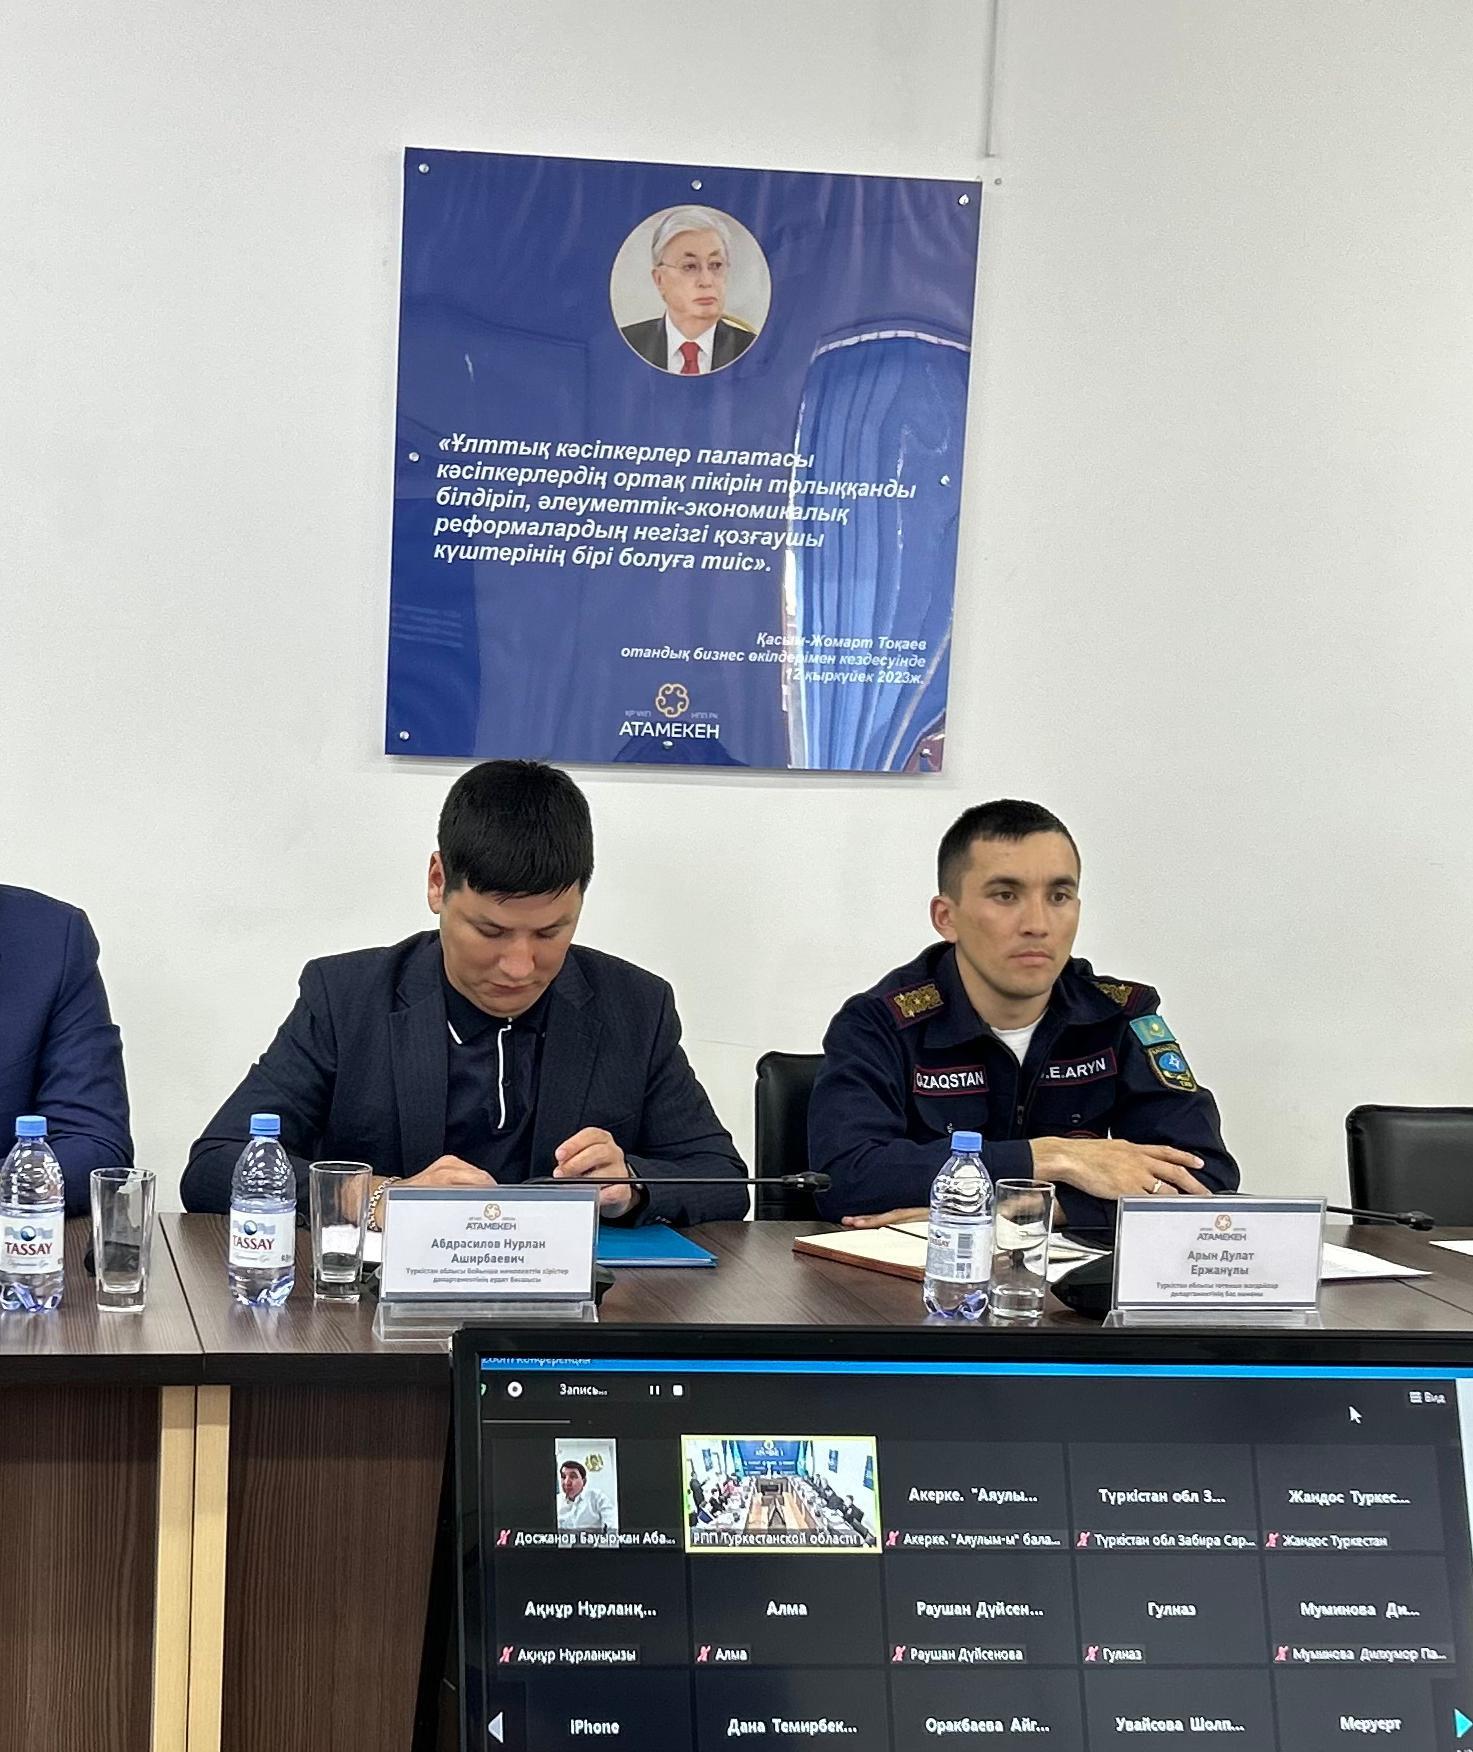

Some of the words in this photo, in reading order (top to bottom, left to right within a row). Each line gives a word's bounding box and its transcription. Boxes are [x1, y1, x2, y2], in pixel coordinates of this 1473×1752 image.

[439, 433, 552, 459] «Ұлттық
[555, 439, 691, 468] кәсіпкерлер
[697, 447, 814, 469] палатасы
[436, 461, 608, 488] кәсіпкерлердің
[613, 471, 686, 493] ортақ
[691, 472, 763, 496] пікірін
[768, 479, 917, 500] толыққанды
[436, 486, 531, 512] білдіріп,
[433, 514, 628, 543] реформалардың
[633, 523, 709, 544] негізгі
[713, 529, 825, 551] қозғаушы
[433, 543, 566, 567] күштерінің
[571, 546, 614, 569] бірі
[618, 547, 695, 573] болуға
[701, 552, 772, 572] тиіс».
[878, 636, 927, 652] Тоқаев
[620, 646, 691, 662] отандық
[693, 647, 745, 662] бизнес
[839, 653, 926, 669] кездесуінде
[878, 671, 925, 685] 2023ж.
[619, 721, 720, 739] АТАМЕКЕН
[1041, 1058, 1106, 1079] .E.ARYN
[466, 1222, 516, 1230] АТАМЕКЕН
[233, 1235, 275, 1250] TASSAY
[1197, 1233, 1246, 1241] АТАМЕКЕН
[5, 1241, 53, 1255] TASSAY
[431, 1239, 501, 1251] Абдрасилов
[504, 1239, 545, 1251] Нурлан
[451, 1253, 524, 1265] Аширбаевич
[1220, 1251, 1254, 1263] Дулат
[909, 1487, 964, 1504] Акерке.
[1172, 1490, 1199, 1502] обл
[1288, 1489, 1344, 1506] Жандос
[515, 1532, 576, 1546] Досжанов
[1153, 1534, 1175, 1546] обл
[1178, 1534, 1220, 1548] Забира
[1283, 1535, 1328, 1547] Жандос
[766, 1601, 807, 1616] Алма
[916, 1602, 971, 1618] Раушан
[1148, 1602, 1196, 1618] Гулназ
[1300, 1602, 1376, 1619] Муминова
[715, 1648, 747, 1660] Алма
[911, 1648, 955, 1663] Раушан
[1103, 1648, 1142, 1663] Гулназ
[727, 1718, 765, 1736] Дана
[925, 1717, 1003, 1734] Оракбаева
[1116, 1717, 1183, 1732] Увайсова
[1340, 1716, 1402, 1733] Меруерт
